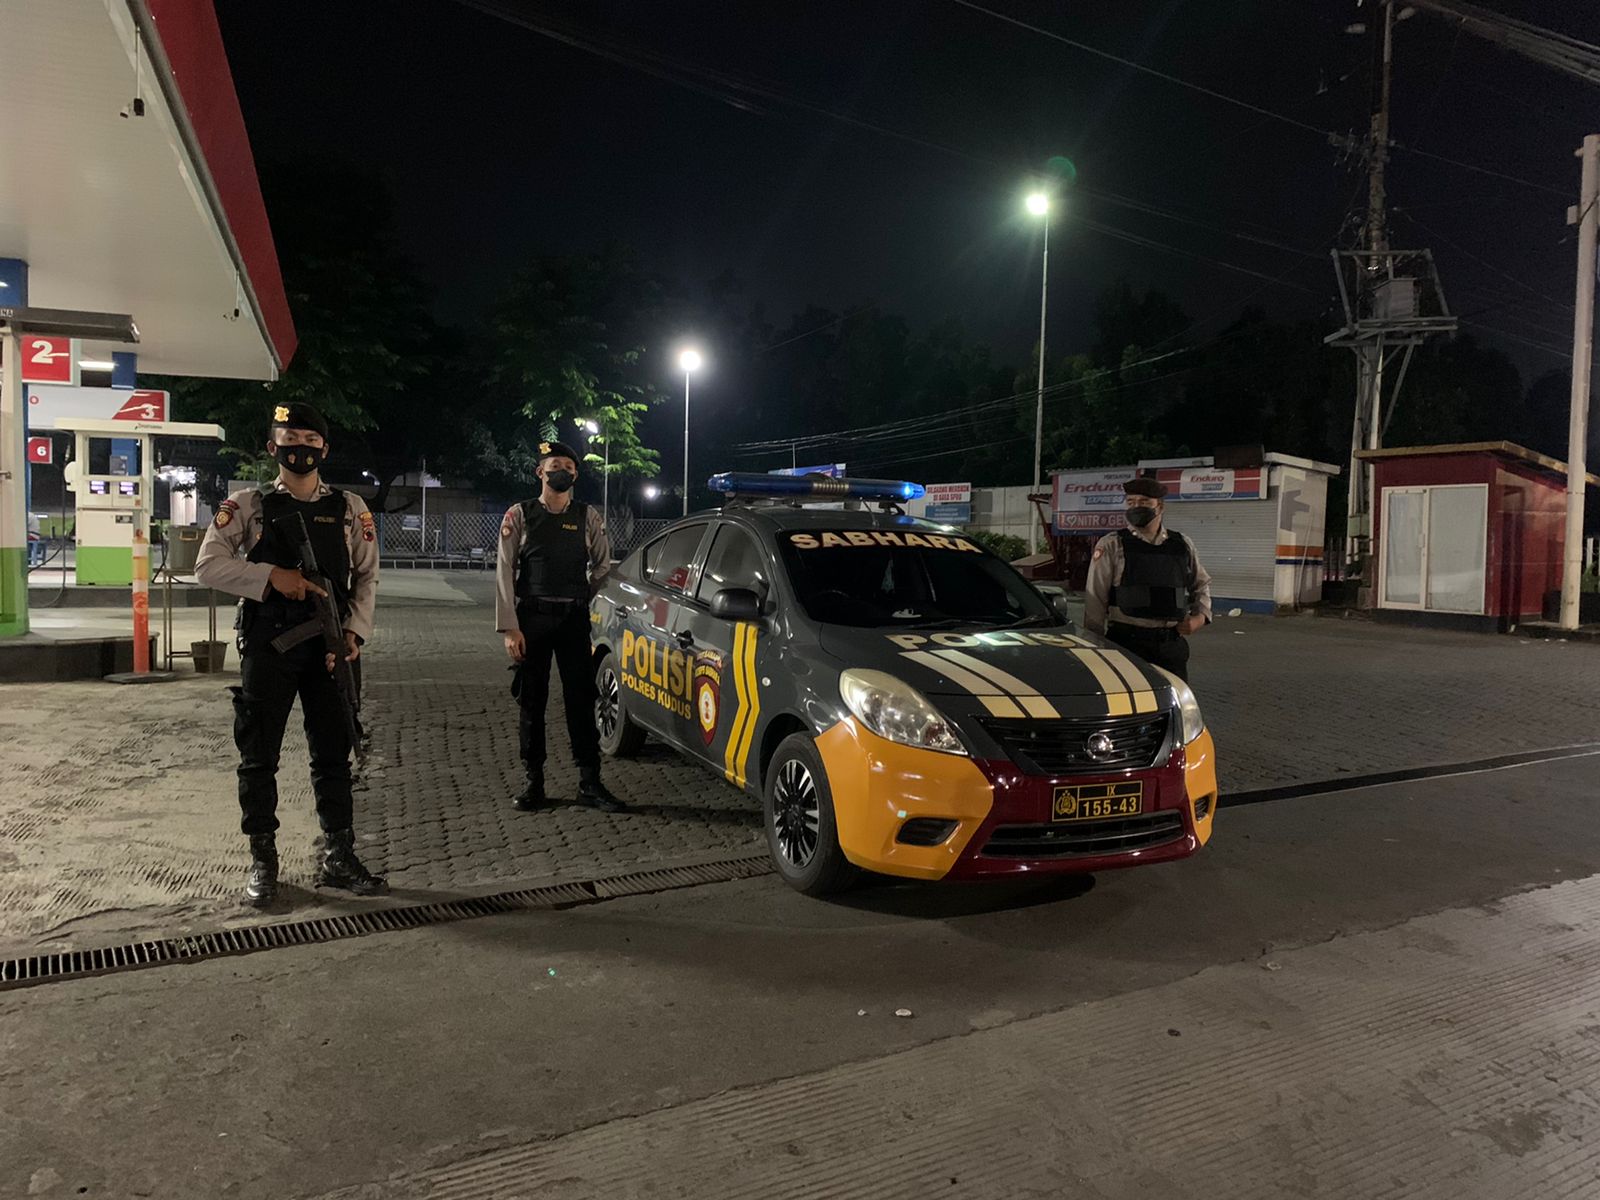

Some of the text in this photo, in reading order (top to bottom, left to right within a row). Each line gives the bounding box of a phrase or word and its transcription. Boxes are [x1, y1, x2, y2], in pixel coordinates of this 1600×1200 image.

[31, 340, 54, 364] 2
[140, 403, 155, 420] 3
[37, 446, 48, 457] 6
[1190, 474, 1225, 483] Enduro
[790, 530, 984, 554] SABHARA
[884, 631, 1098, 650] POLISI
[621, 629, 694, 702] POLISI
[621, 671, 692, 720] POLRES KUDUS
[1106, 784, 1117, 797] IX
[1083, 797, 1138, 817] 155-43
